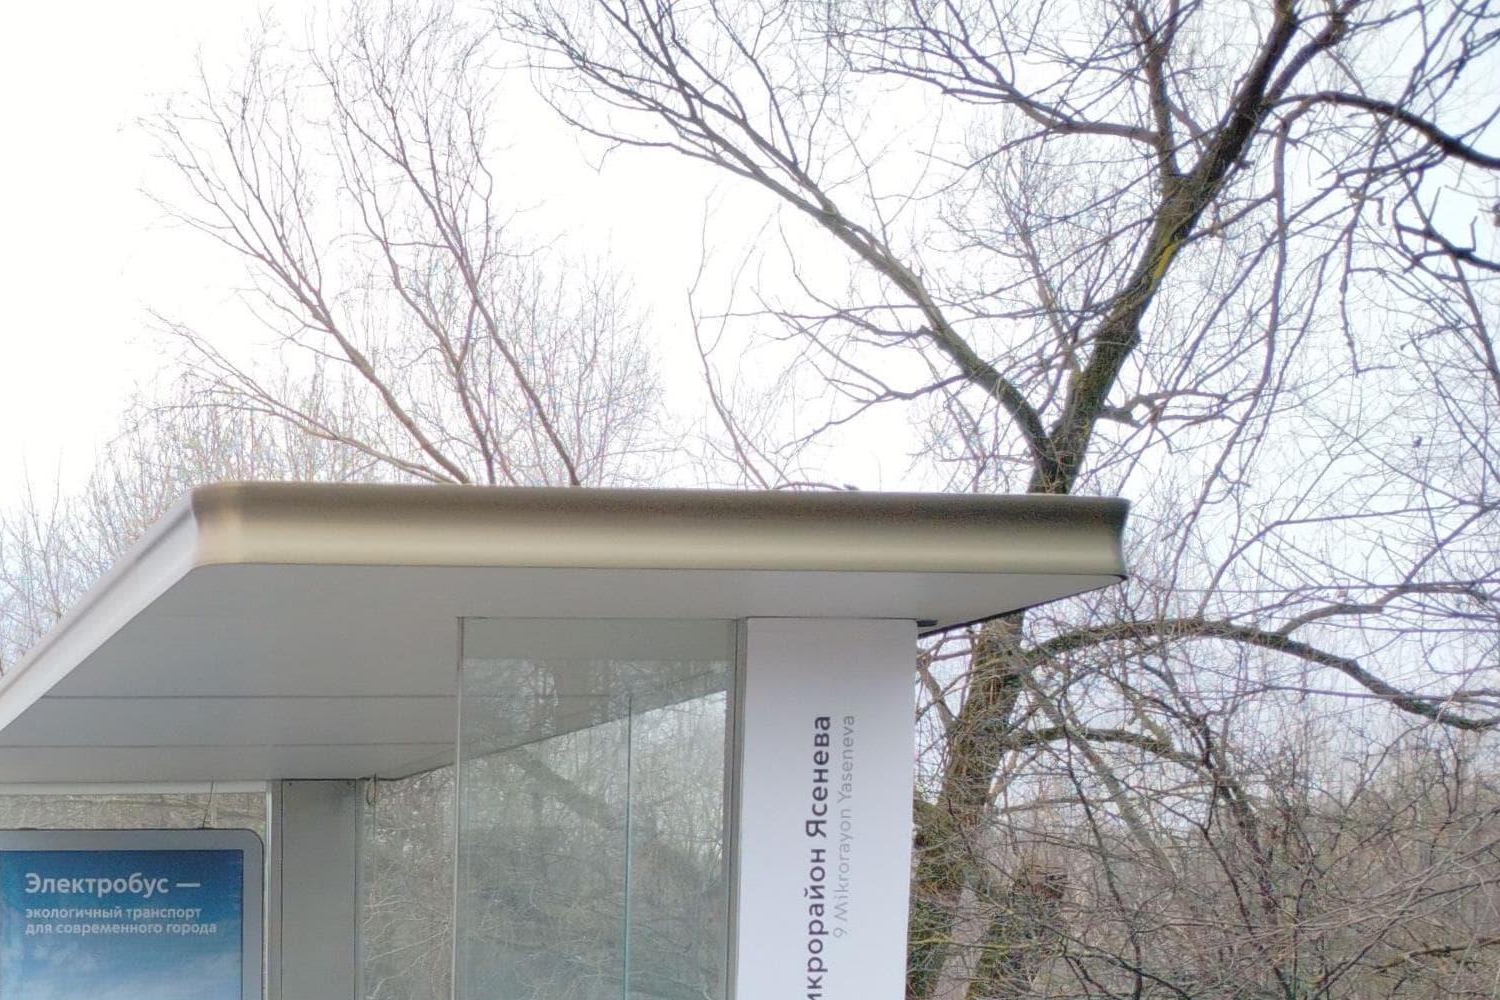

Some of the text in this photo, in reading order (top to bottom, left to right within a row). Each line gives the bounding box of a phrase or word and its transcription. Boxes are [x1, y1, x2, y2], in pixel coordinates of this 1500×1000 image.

[805, 715, 831, 838] Ясенева
[832, 715, 855, 938] 9 Mikrorayon Yaseneva
[24, 872, 169, 898] Электробус
[25, 906, 202, 919] экологичный транспорт
[25, 922, 217, 936] для современного города
